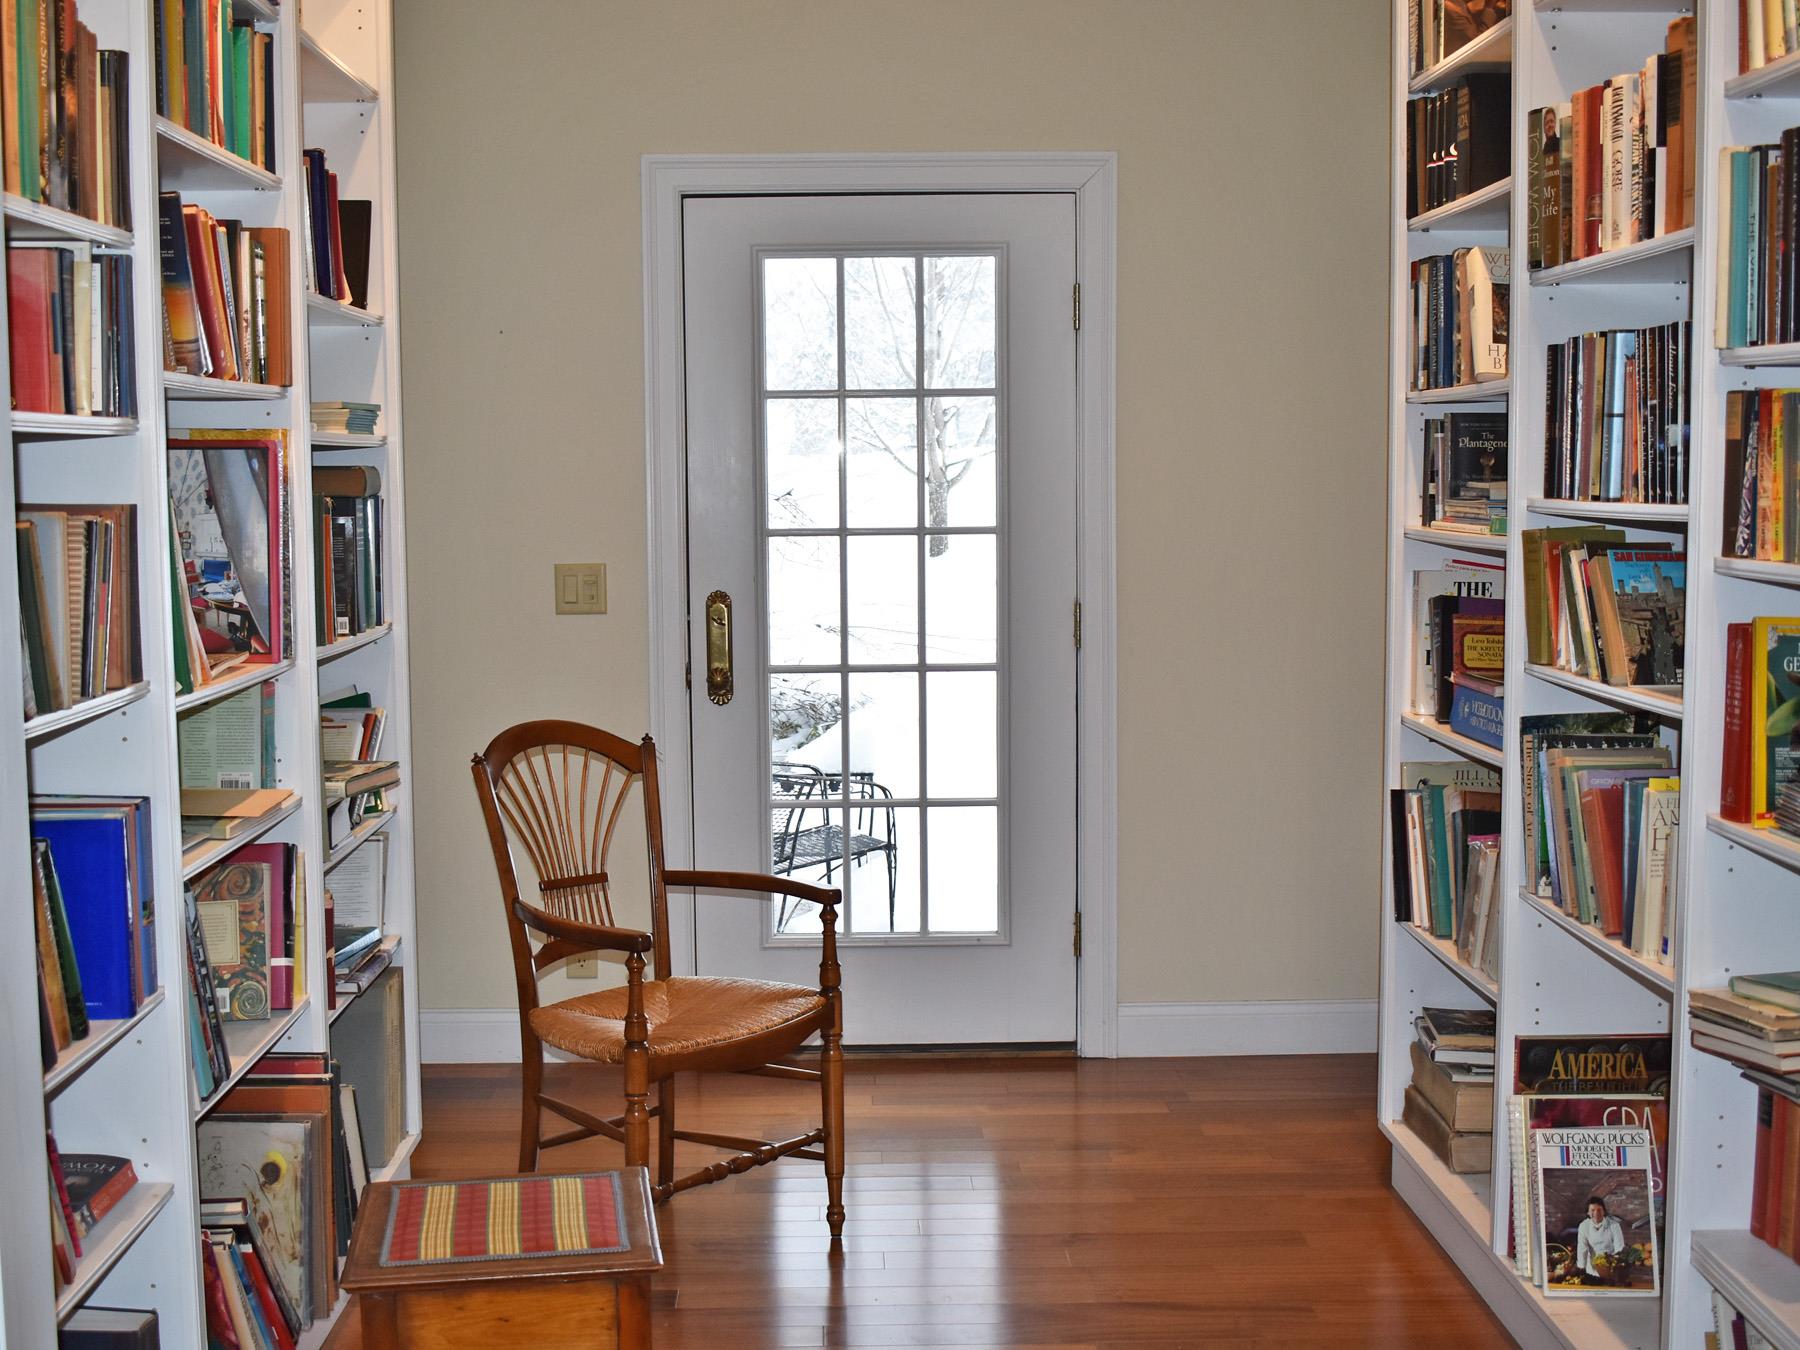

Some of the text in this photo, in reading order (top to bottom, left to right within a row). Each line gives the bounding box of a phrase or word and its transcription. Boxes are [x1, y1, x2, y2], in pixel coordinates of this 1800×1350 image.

[1612, 86, 1623, 144] HOLLYWOOD
[1612, 150, 1624, 192] GORE
[1528, 129, 1540, 249] TOM WOLFE
[1543, 187, 1557, 204] My
[1542, 203, 1558, 218] Life
[1748, 212, 1756, 241] THE
[1669, 341, 1677, 409] About Face
[1482, 432, 1495, 440] The
[1750, 421, 1759, 478] Second Growth
[1526, 739, 1534, 763] The
[1525, 765, 1534, 799] Story
[1526, 801, 1533, 816] of
[1547, 1048, 1649, 1080] AMERICA
[1541, 1131, 1645, 1145] WOLFGANG PUCK'S
[1570, 1159, 1616, 1167] COOKING
[1571, 1152, 1614, 1160] FRENCH
